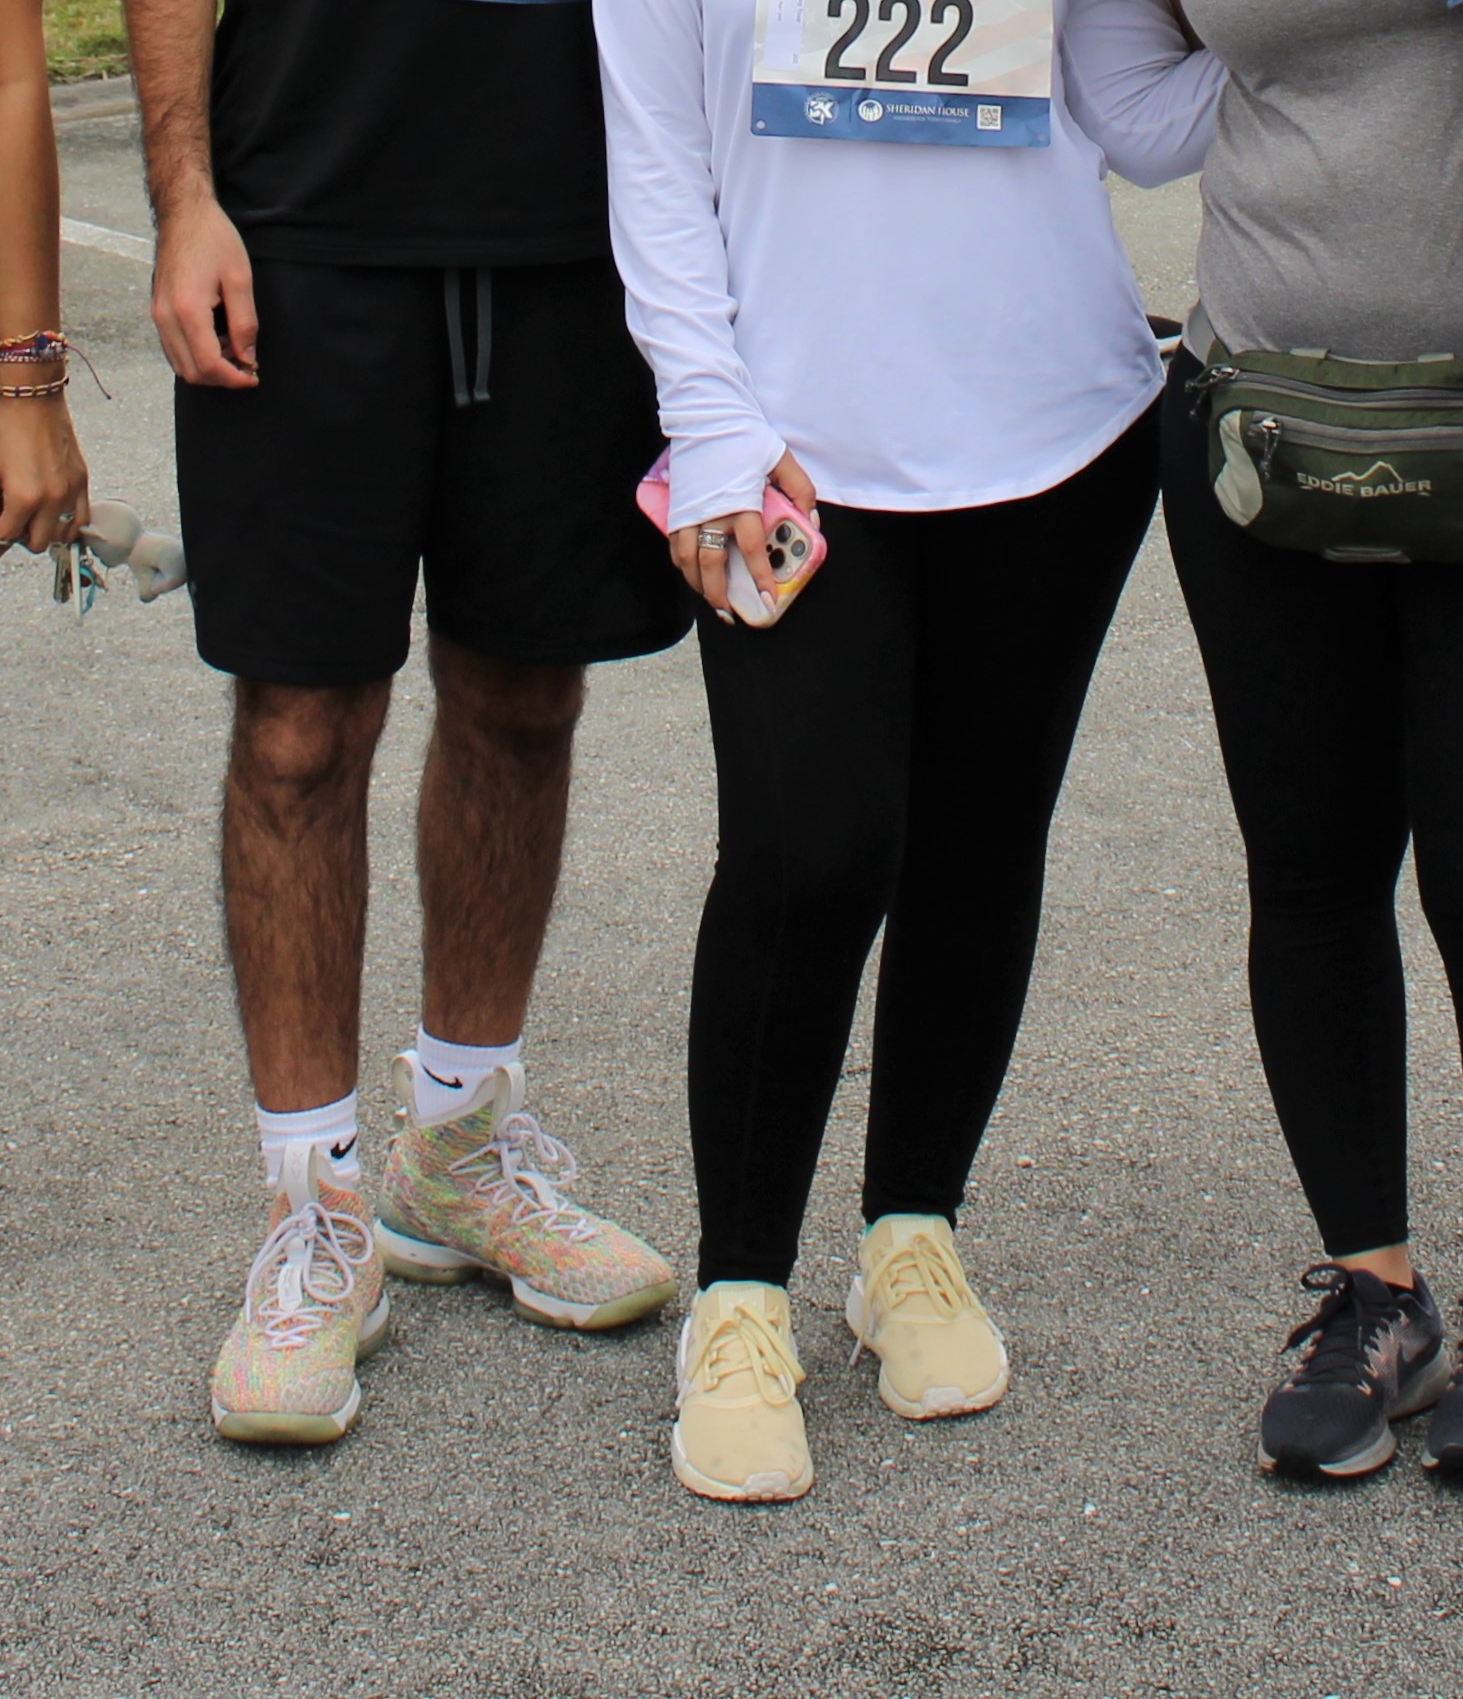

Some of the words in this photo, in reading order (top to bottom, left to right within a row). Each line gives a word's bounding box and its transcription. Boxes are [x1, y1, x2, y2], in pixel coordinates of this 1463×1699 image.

[885, 103, 935, 116] SHERIDAN
[937, 106, 970, 119] HOUSE
[1296, 471, 1355, 497] EDDIE
[1359, 479, 1432, 498] BAUER
